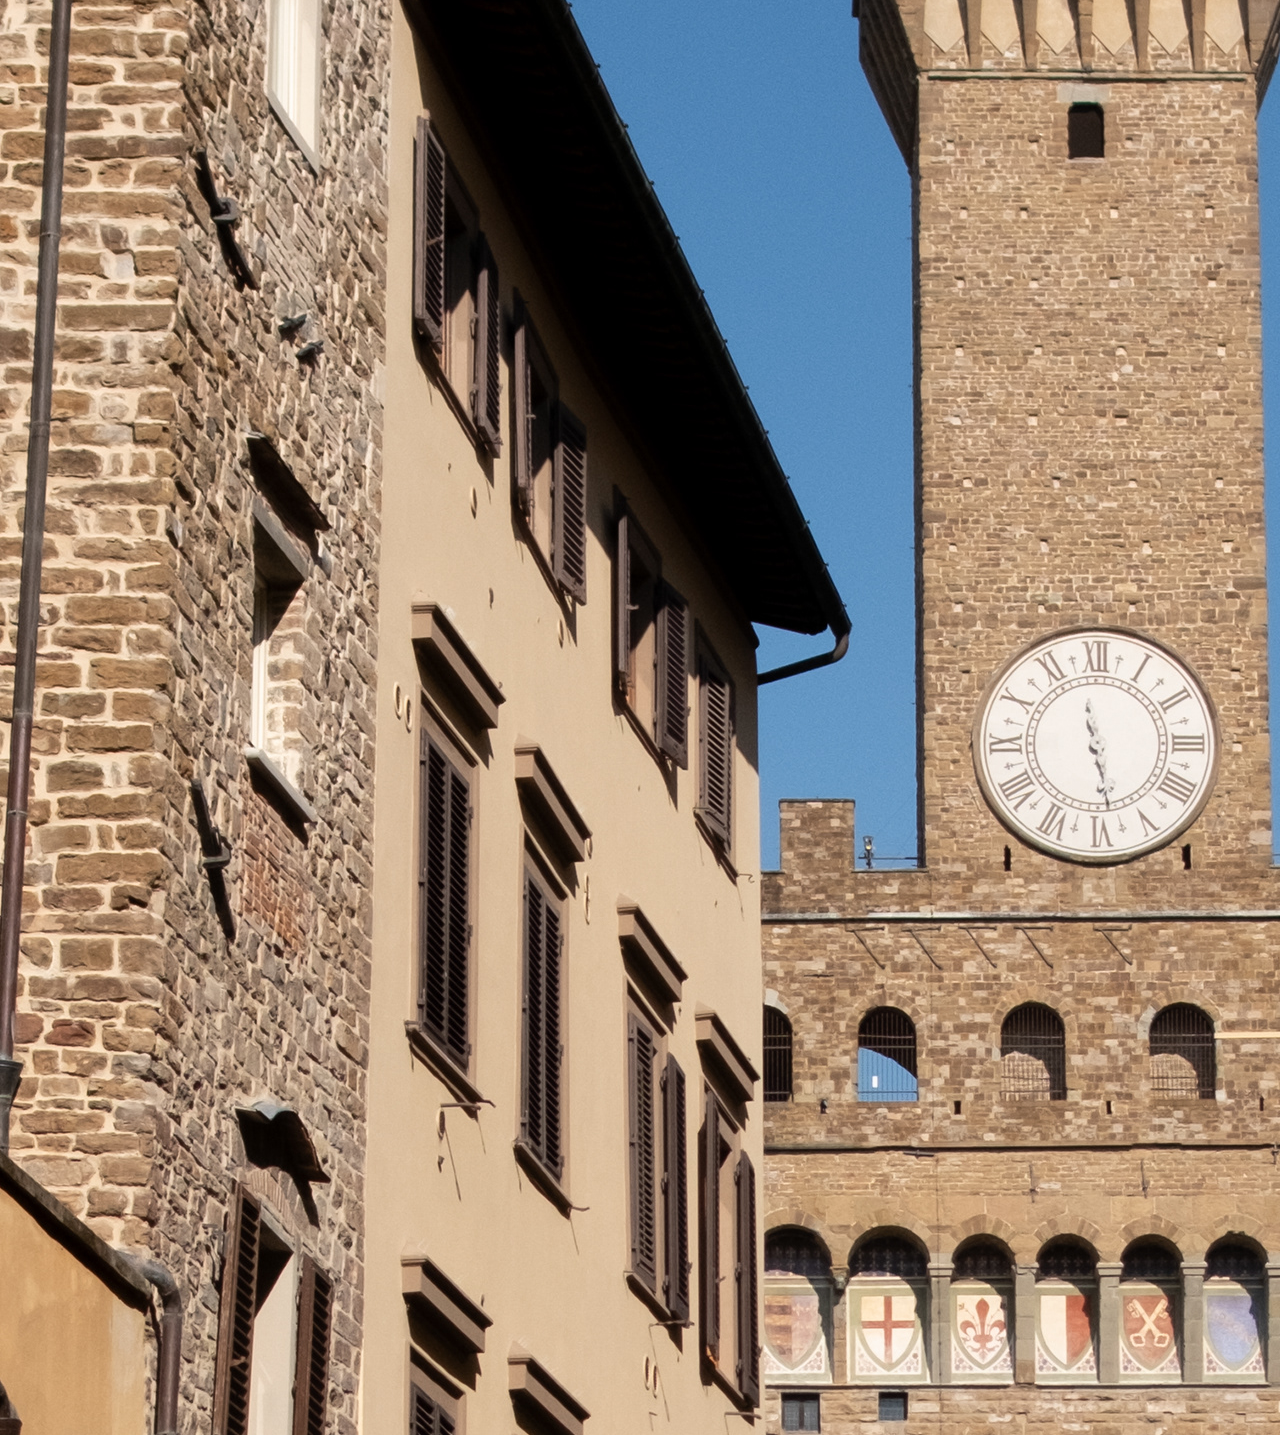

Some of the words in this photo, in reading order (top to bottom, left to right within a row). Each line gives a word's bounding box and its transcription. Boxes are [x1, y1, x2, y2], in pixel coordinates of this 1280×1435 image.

[1033, 649, 1068, 687] XI
[1081, 641, 1111, 674] XII
[1130, 652, 1153, 683] I
[999, 686, 1035, 715] X
[1156, 685, 1193, 715] II
[988, 732, 1024, 756] IX
[1170, 732, 1206, 755] III
[998, 768, 1037, 813] VIII
[1156, 769, 1198, 807] IIII
[1035, 801, 1066, 842] VII
[1089, 815, 1114, 848] VI
[1136, 806, 1160, 838] V
